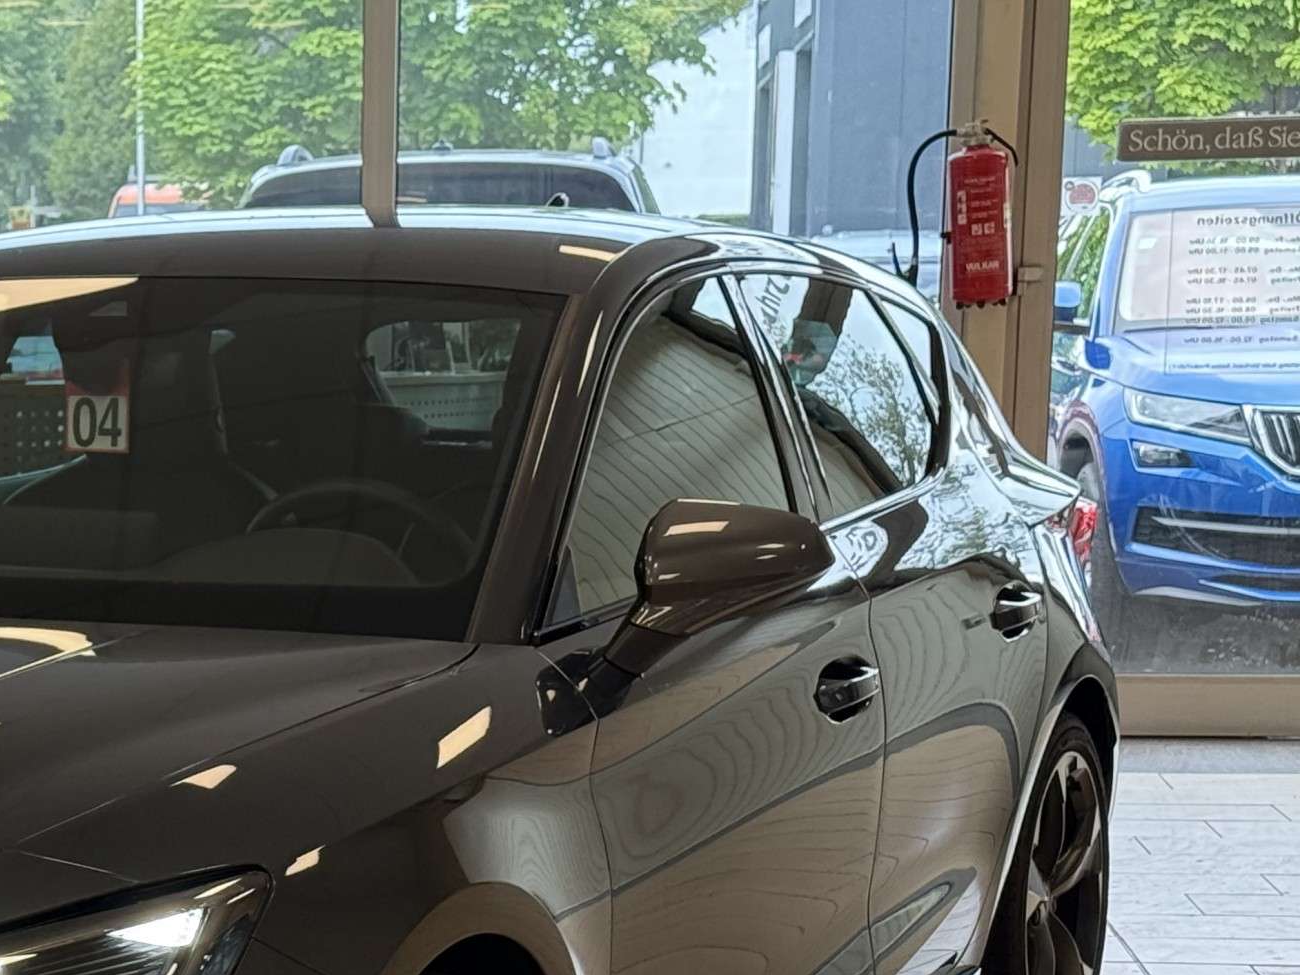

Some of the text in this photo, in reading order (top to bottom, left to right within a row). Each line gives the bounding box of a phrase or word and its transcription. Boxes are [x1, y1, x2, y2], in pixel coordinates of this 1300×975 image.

[1128, 125, 1300, 154] Schön, daß Sie
[73, 397, 122, 448] 04
